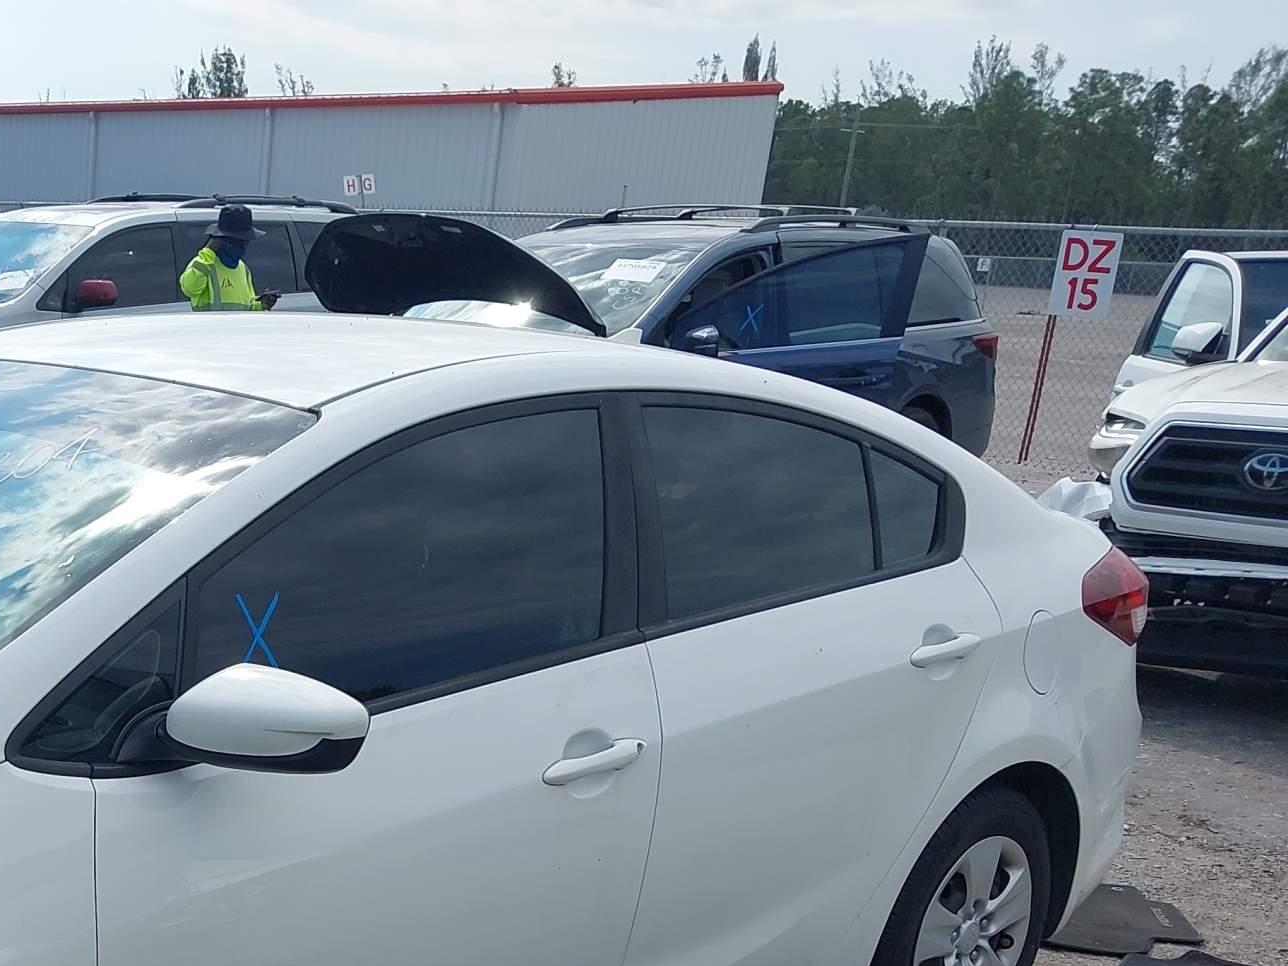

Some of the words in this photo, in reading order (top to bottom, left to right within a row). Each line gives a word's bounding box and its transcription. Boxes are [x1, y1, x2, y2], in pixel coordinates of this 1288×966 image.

[346, 179, 356, 193] H
[363, 177, 372, 191] G
[1062, 237, 1116, 274] DZ
[1067, 277, 1099, 311] 15
